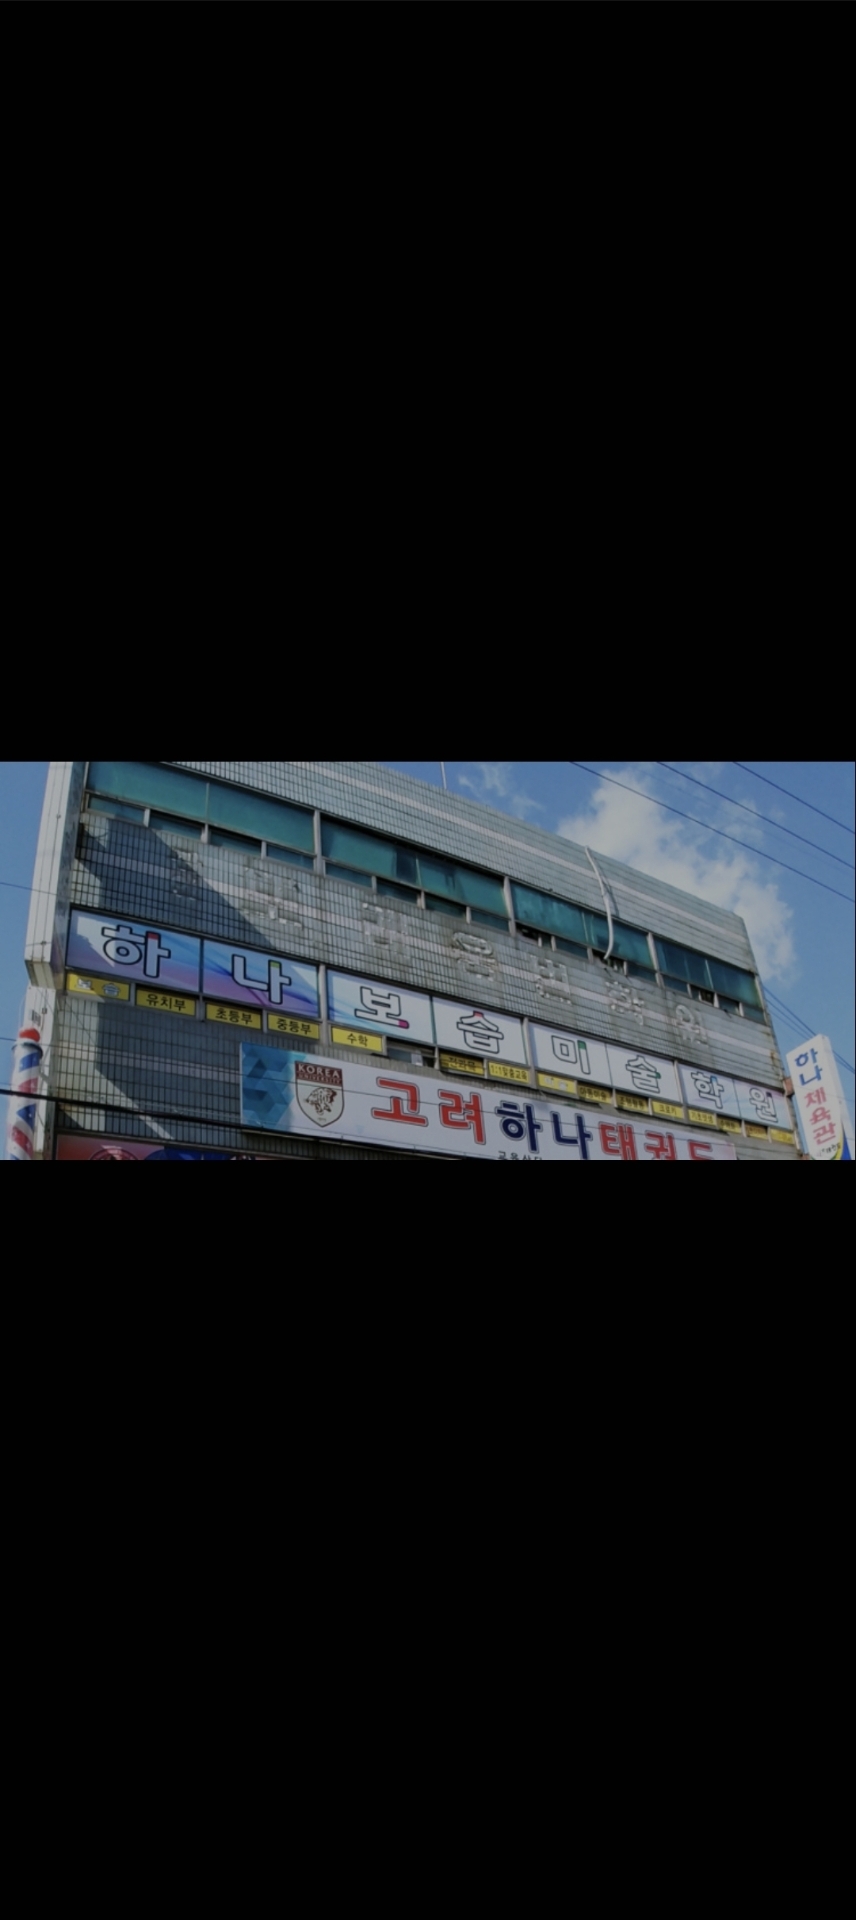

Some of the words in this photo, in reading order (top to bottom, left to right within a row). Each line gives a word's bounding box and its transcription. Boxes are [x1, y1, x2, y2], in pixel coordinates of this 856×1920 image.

[146, 994, 187, 1012] 유치부
[215, 1006, 252, 1025] 초등부
[276, 1018, 312, 1035] 중등부
[346, 1033, 369, 1047] 수학
[297, 1072, 341, 1084] UNIVERSITY
[298, 1063, 340, 1078] KOREA
[490, 1064, 528, 1081] 1:1맞춤교육
